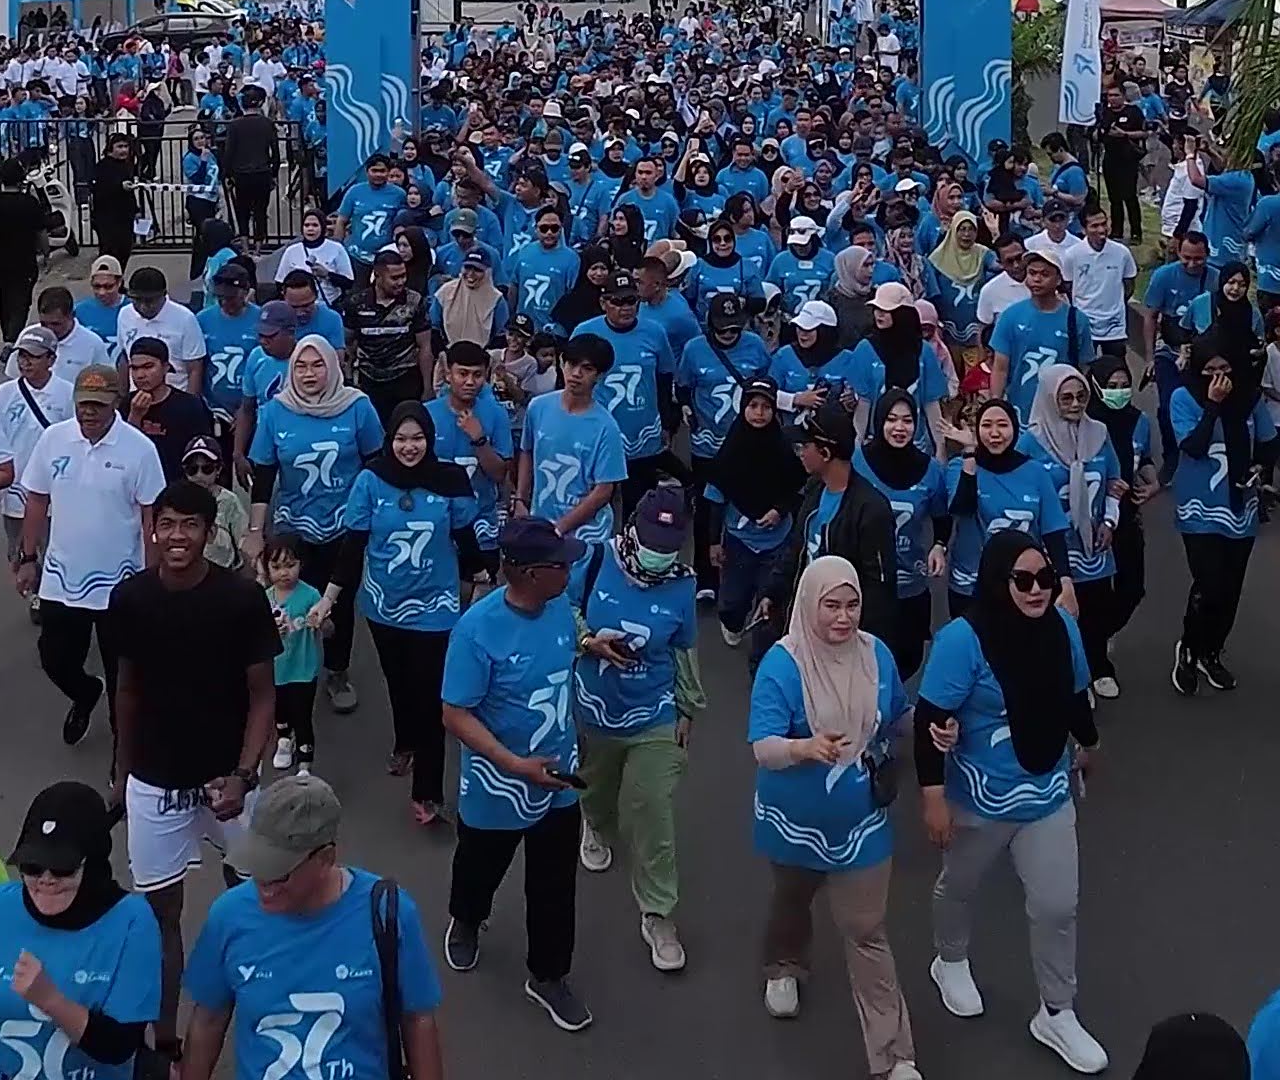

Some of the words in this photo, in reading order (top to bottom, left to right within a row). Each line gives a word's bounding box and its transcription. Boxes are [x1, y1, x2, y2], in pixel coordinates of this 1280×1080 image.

[292, 441, 339, 497] 57
[538, 453, 581, 508] 57
[387, 520, 434, 574] 57
[256, 991, 346, 1080] 57
[326, 1058, 354, 1080] Th
